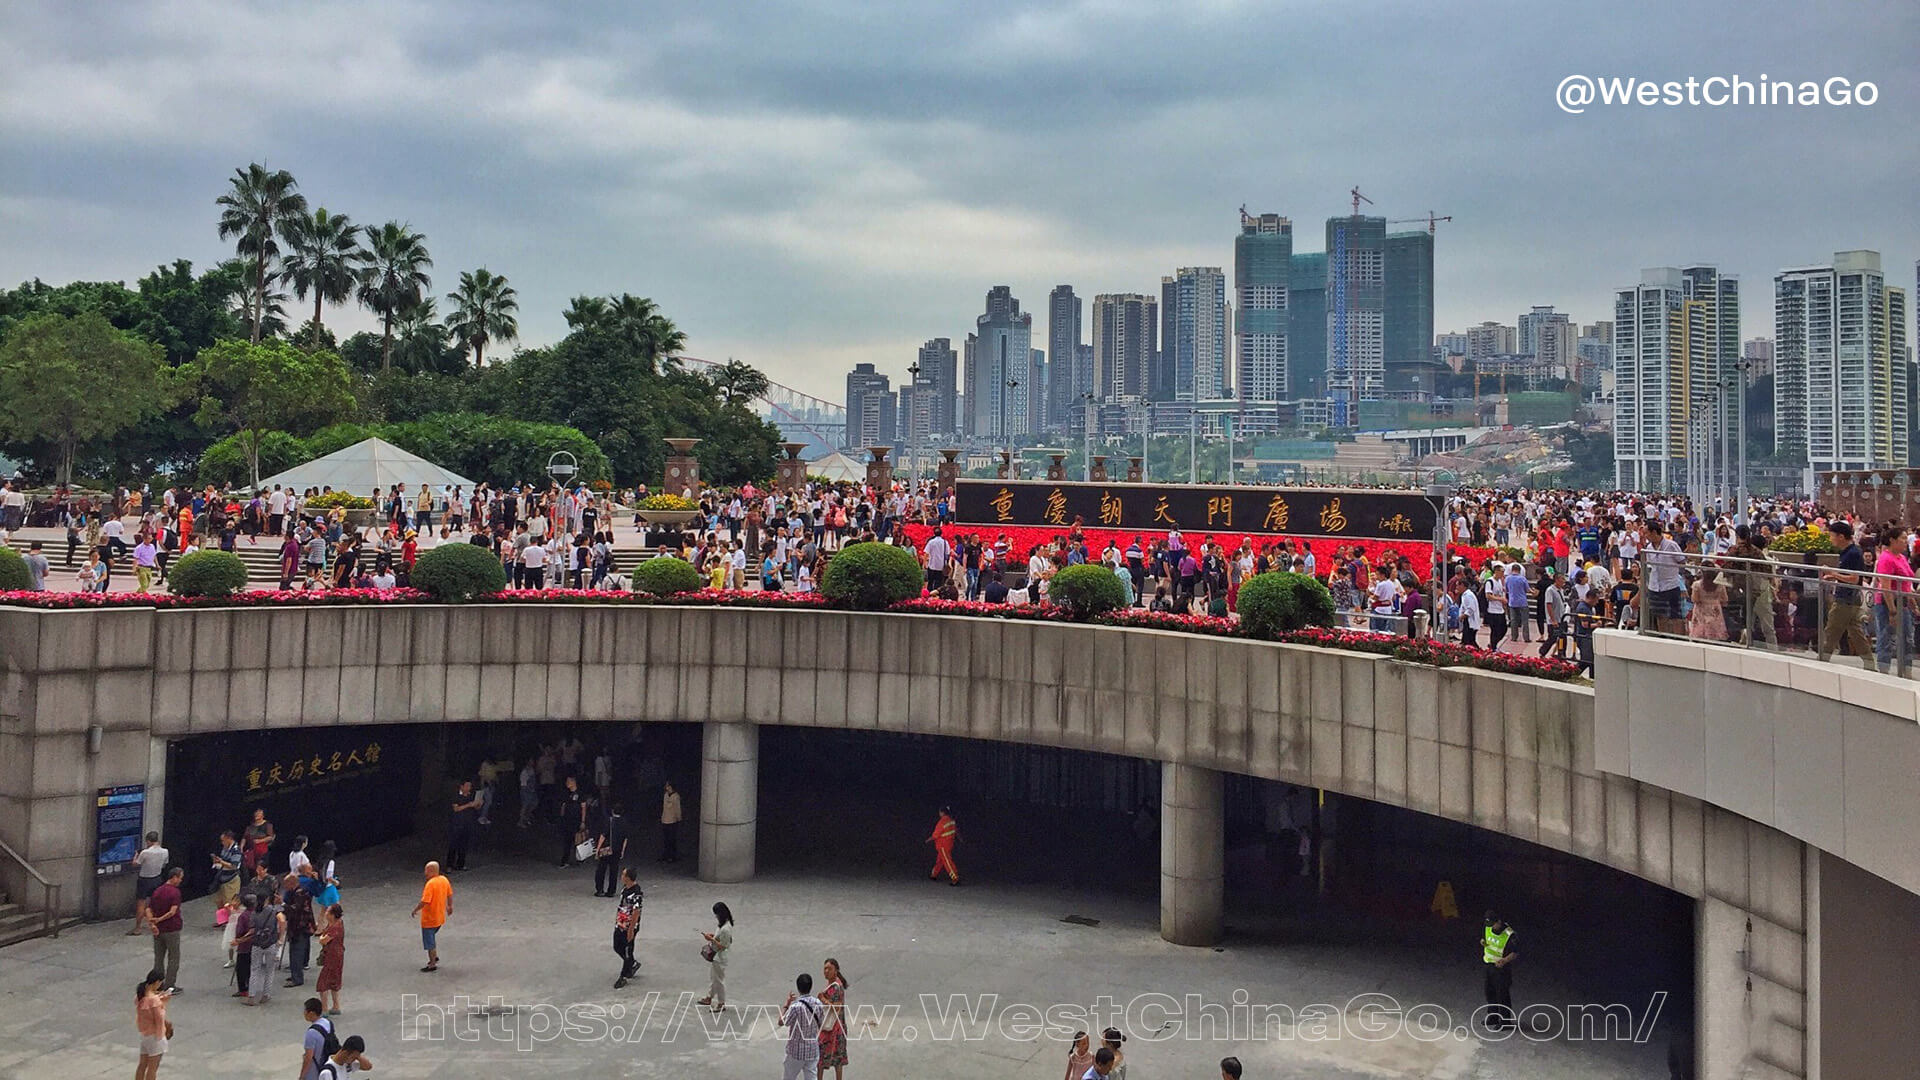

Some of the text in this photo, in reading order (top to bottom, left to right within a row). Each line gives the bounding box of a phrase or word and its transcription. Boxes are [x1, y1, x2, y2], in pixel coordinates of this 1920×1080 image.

[989, 487, 1347, 532] 重慶朝天門廣場
[246, 742, 381, 792] 重庆历史名人馆
